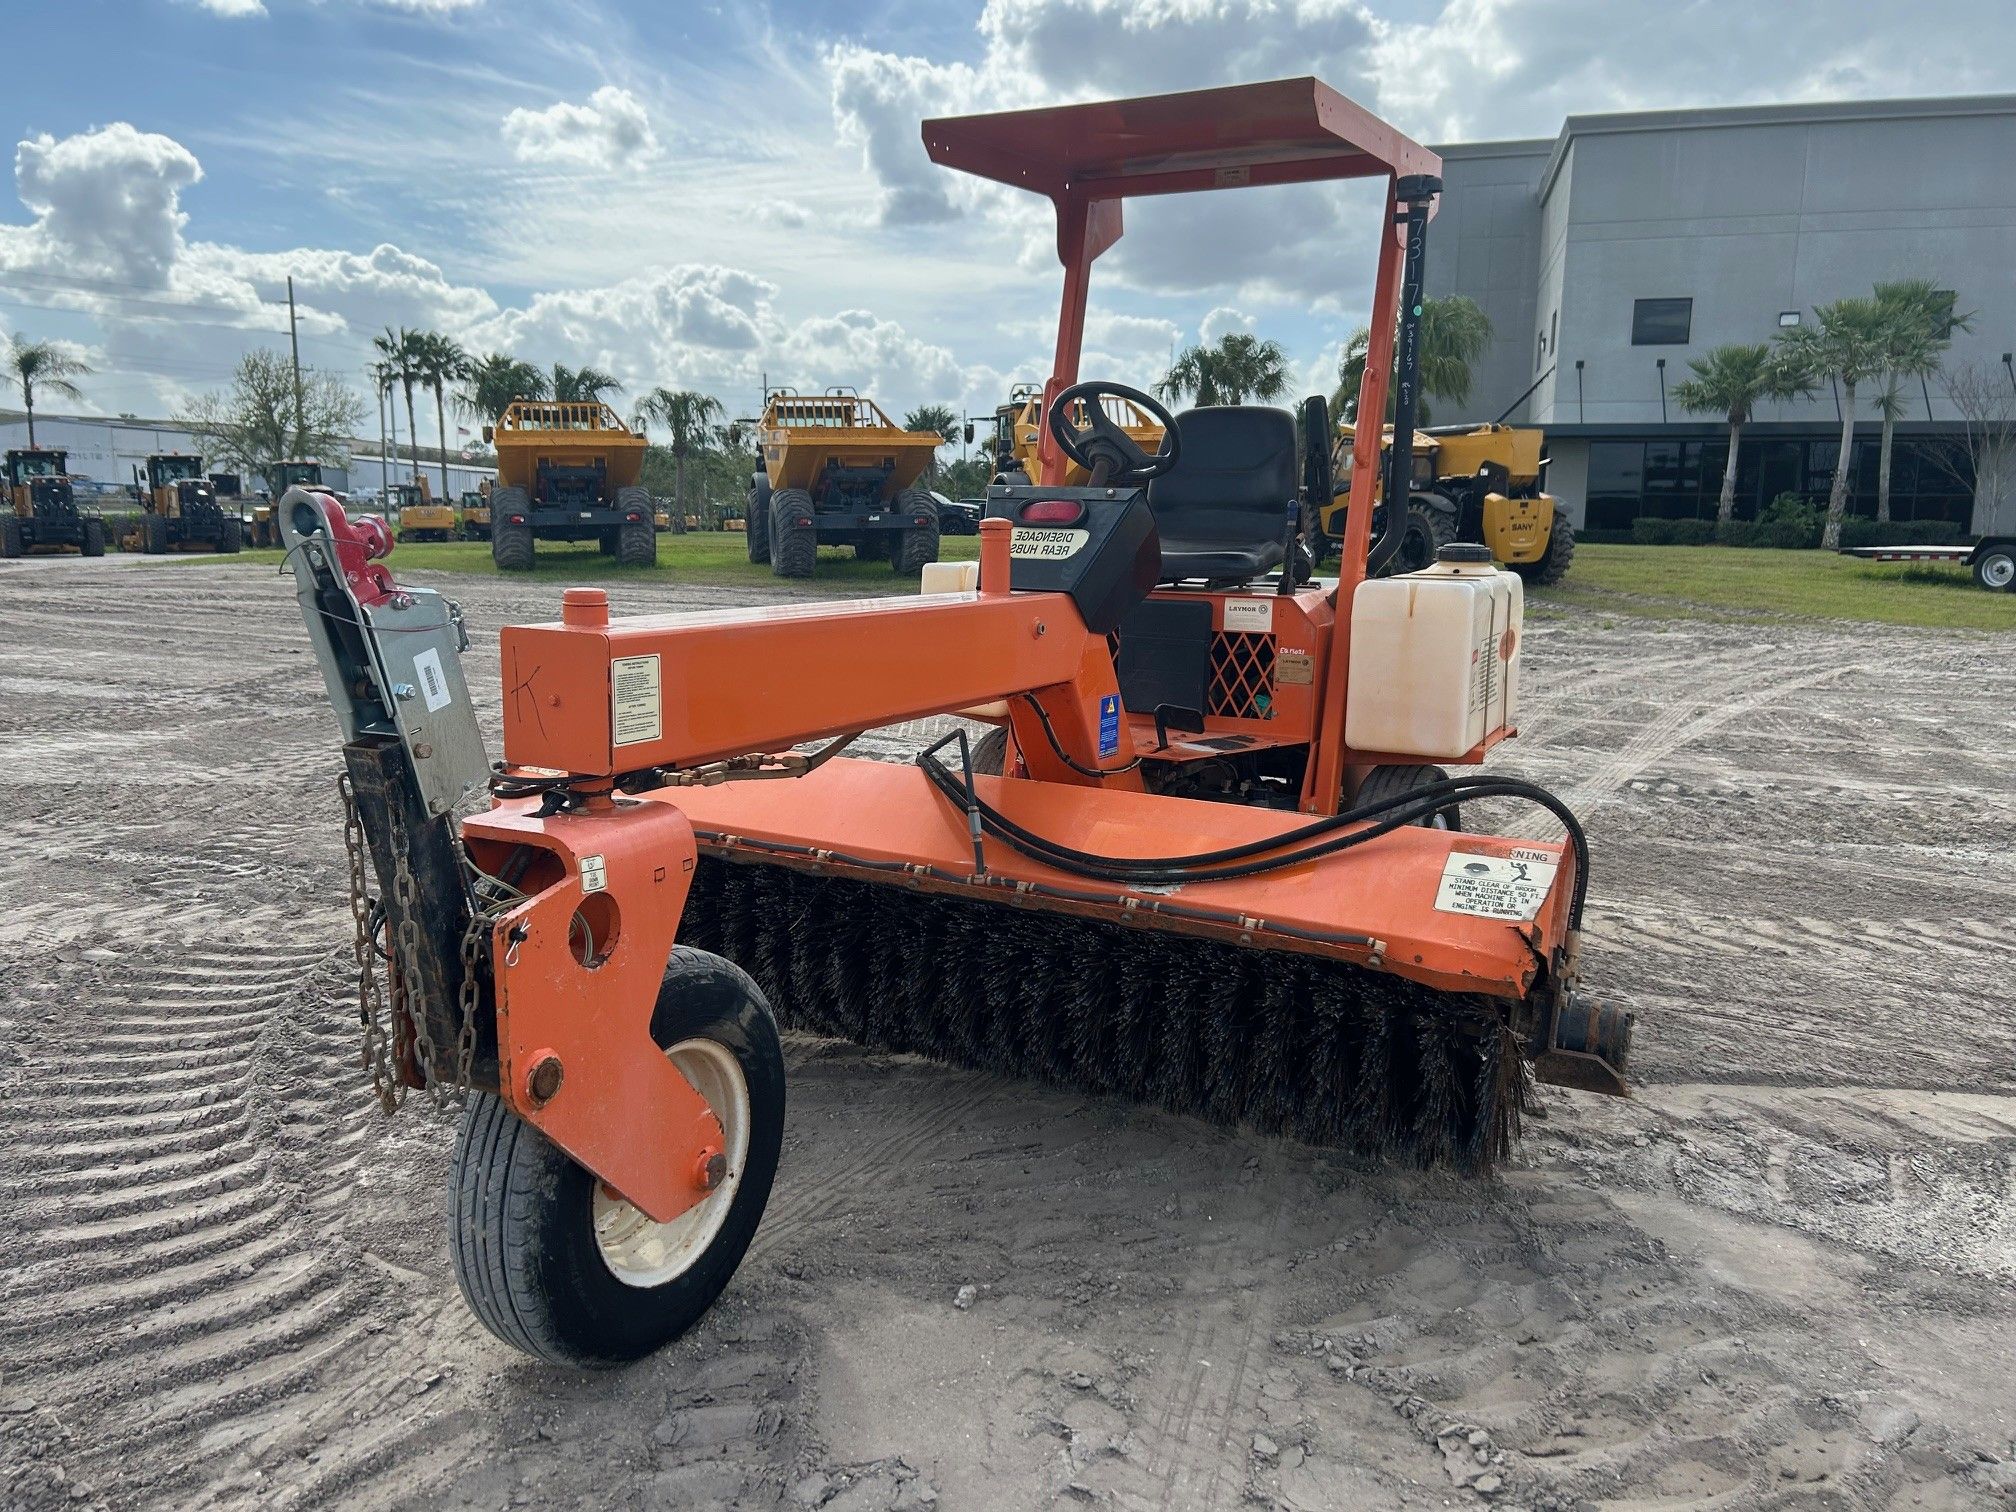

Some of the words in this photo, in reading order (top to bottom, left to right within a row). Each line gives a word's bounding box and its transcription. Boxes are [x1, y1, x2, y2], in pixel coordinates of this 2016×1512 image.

[1408, 219, 1424, 305] 7317
[1512, 523, 1533, 531] SANY
[1449, 884, 1478, 892] MINIMUM
[1481, 888, 1515, 896] DISTANCE
[1455, 890, 1472, 898] WHEN
[1475, 893, 1505, 901] MACHINE
[1465, 898, 1504, 908] OPERATION
[1452, 902, 1477, 911] ENGINE
[1492, 908, 1523, 917] RUNNING
